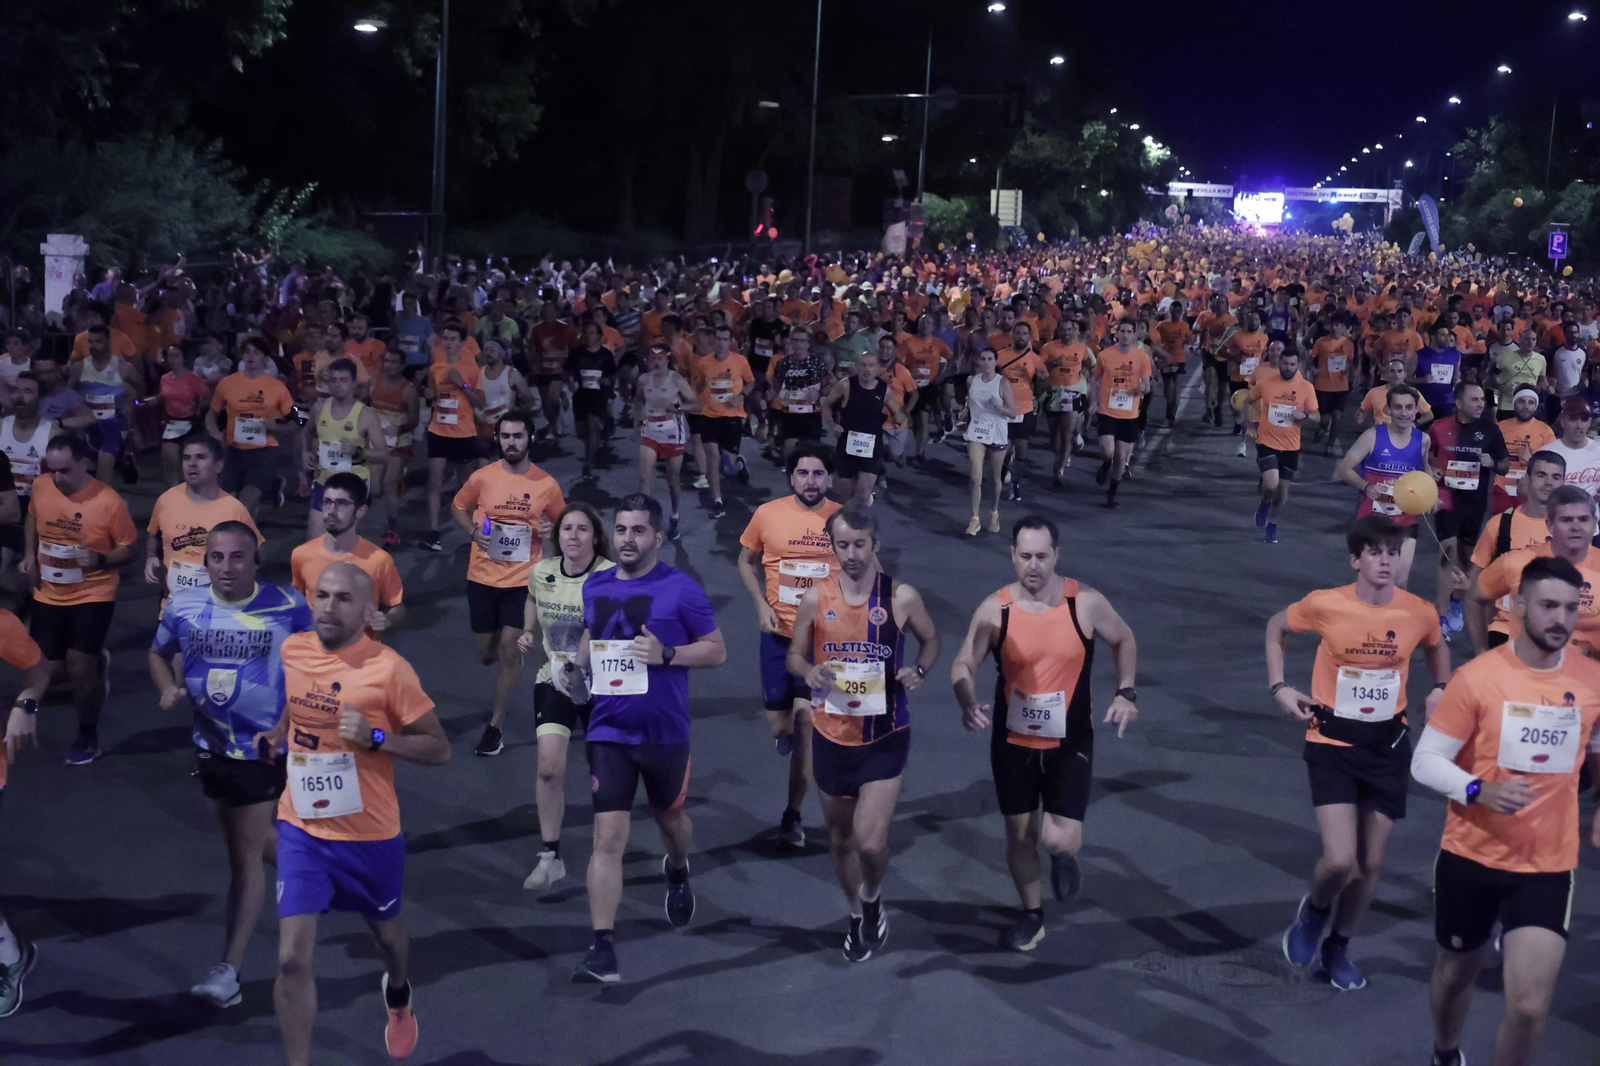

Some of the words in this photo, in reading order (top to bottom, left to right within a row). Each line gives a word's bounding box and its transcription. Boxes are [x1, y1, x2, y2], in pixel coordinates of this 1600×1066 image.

[1553, 235, 1564, 247] P
[327, 450, 344, 459] 5814
[1378, 462, 1416, 472] CREDUS
[498, 536, 521, 547] 4840
[176, 574, 198, 587] 6041
[794, 576, 813, 588] 730
[1344, 647, 1377, 655] SEVILLA
[1361, 642, 1398, 650] NOCTURNA
[601, 658, 635, 672] 17754
[845, 680, 867, 695] 295
[1351, 686, 1389, 701] 13436
[289, 695, 319, 710] SEVILLA
[1022, 707, 1051, 720] 5578
[1520, 727, 1568, 746] 20567
[301, 775, 343, 792] 16510
